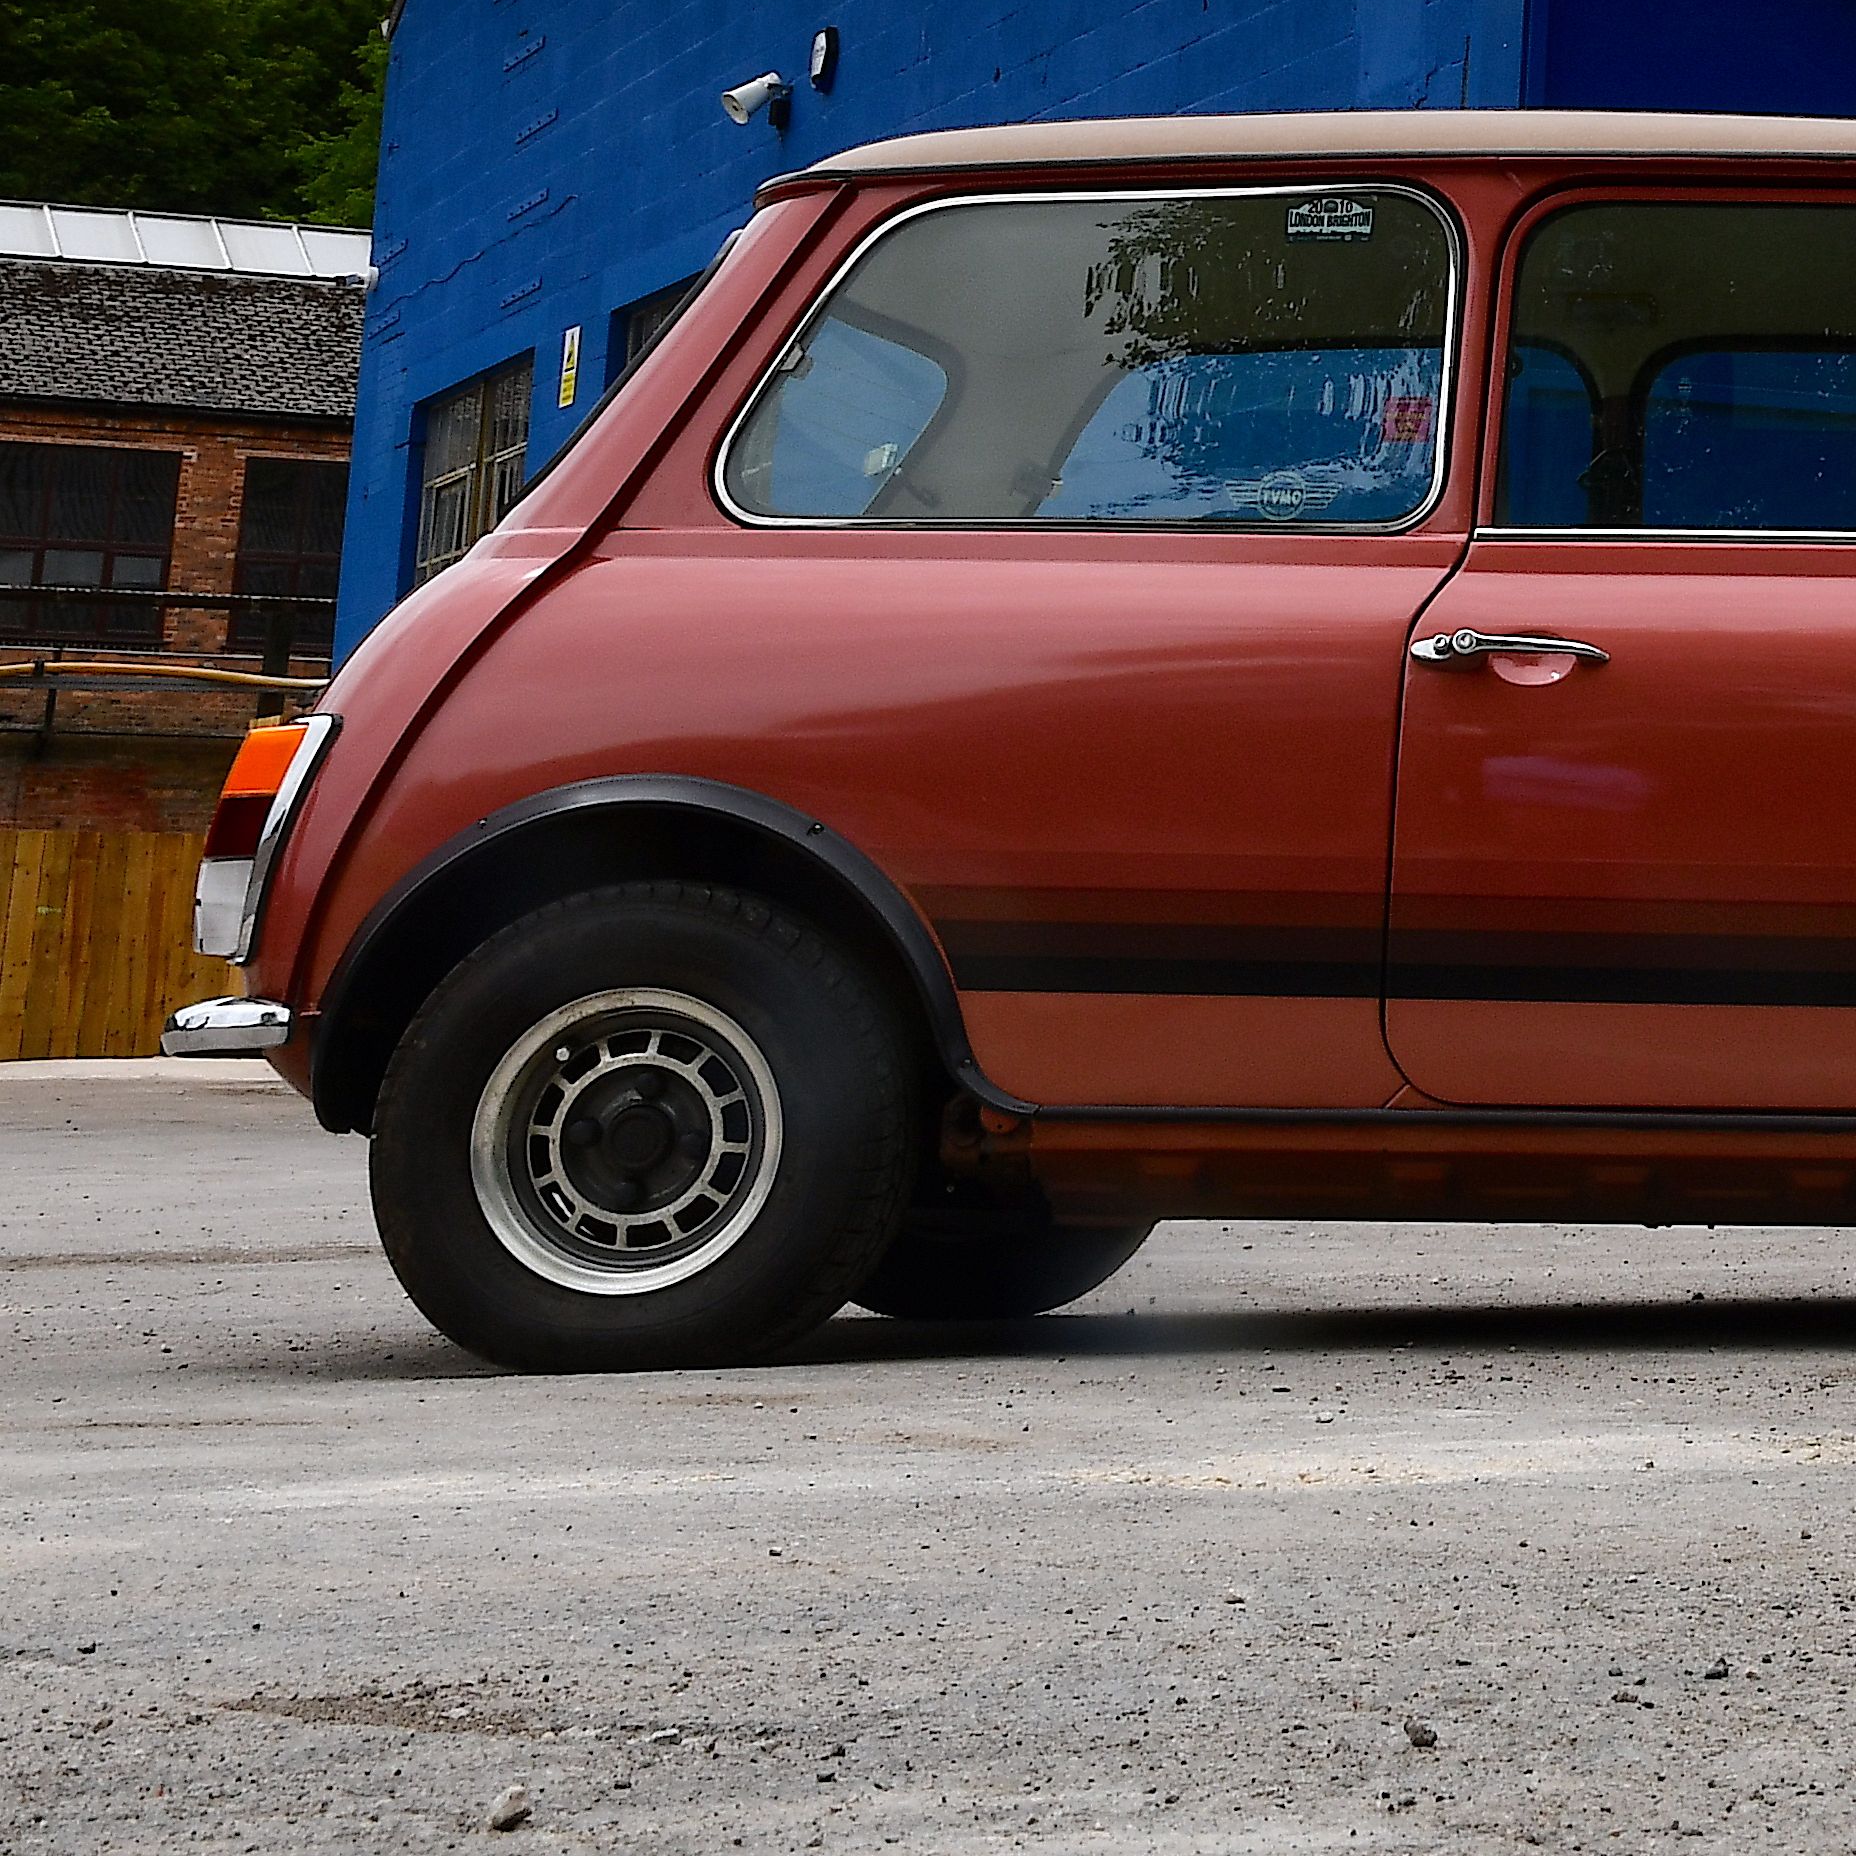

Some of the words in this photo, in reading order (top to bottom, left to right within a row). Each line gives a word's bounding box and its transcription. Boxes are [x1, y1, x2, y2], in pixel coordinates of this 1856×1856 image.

[1308, 198, 1323, 214] 20
[1289, 211, 1325, 227] LONDON
[1326, 210, 1371, 227] BRIGHTON
